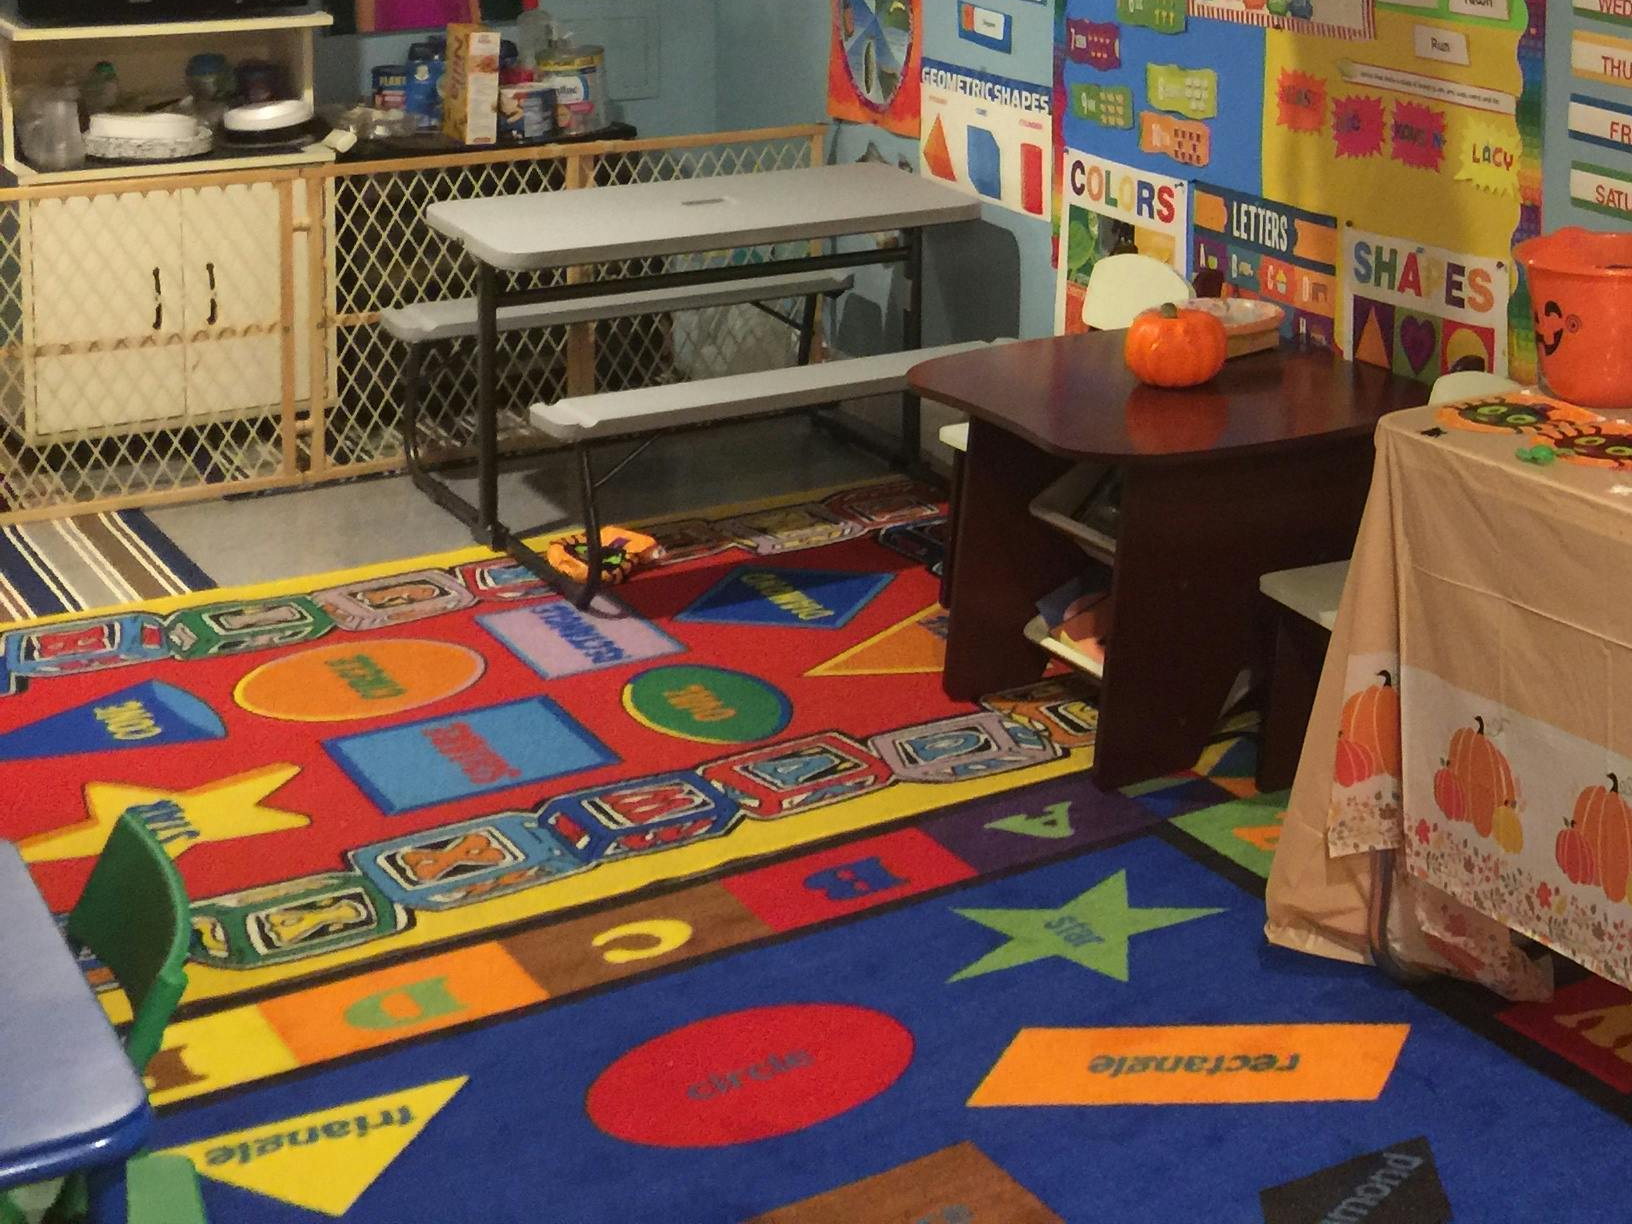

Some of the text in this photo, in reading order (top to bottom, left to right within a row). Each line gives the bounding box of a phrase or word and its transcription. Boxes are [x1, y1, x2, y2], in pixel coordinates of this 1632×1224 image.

[922, 66, 1051, 115] GEOMETRIC SHAPES
[1472, 142, 1514, 171] LACY
[1071, 159, 1175, 223] COLORS
[1232, 201, 1288, 253] LETTERS
[1354, 241, 1494, 312] SHAPES
[1045, 916, 1104, 947] star
[687, 1049, 815, 1101] circle
[1088, 1052, 1300, 1077] rectangle
[204, 1105, 415, 1167] triangle
